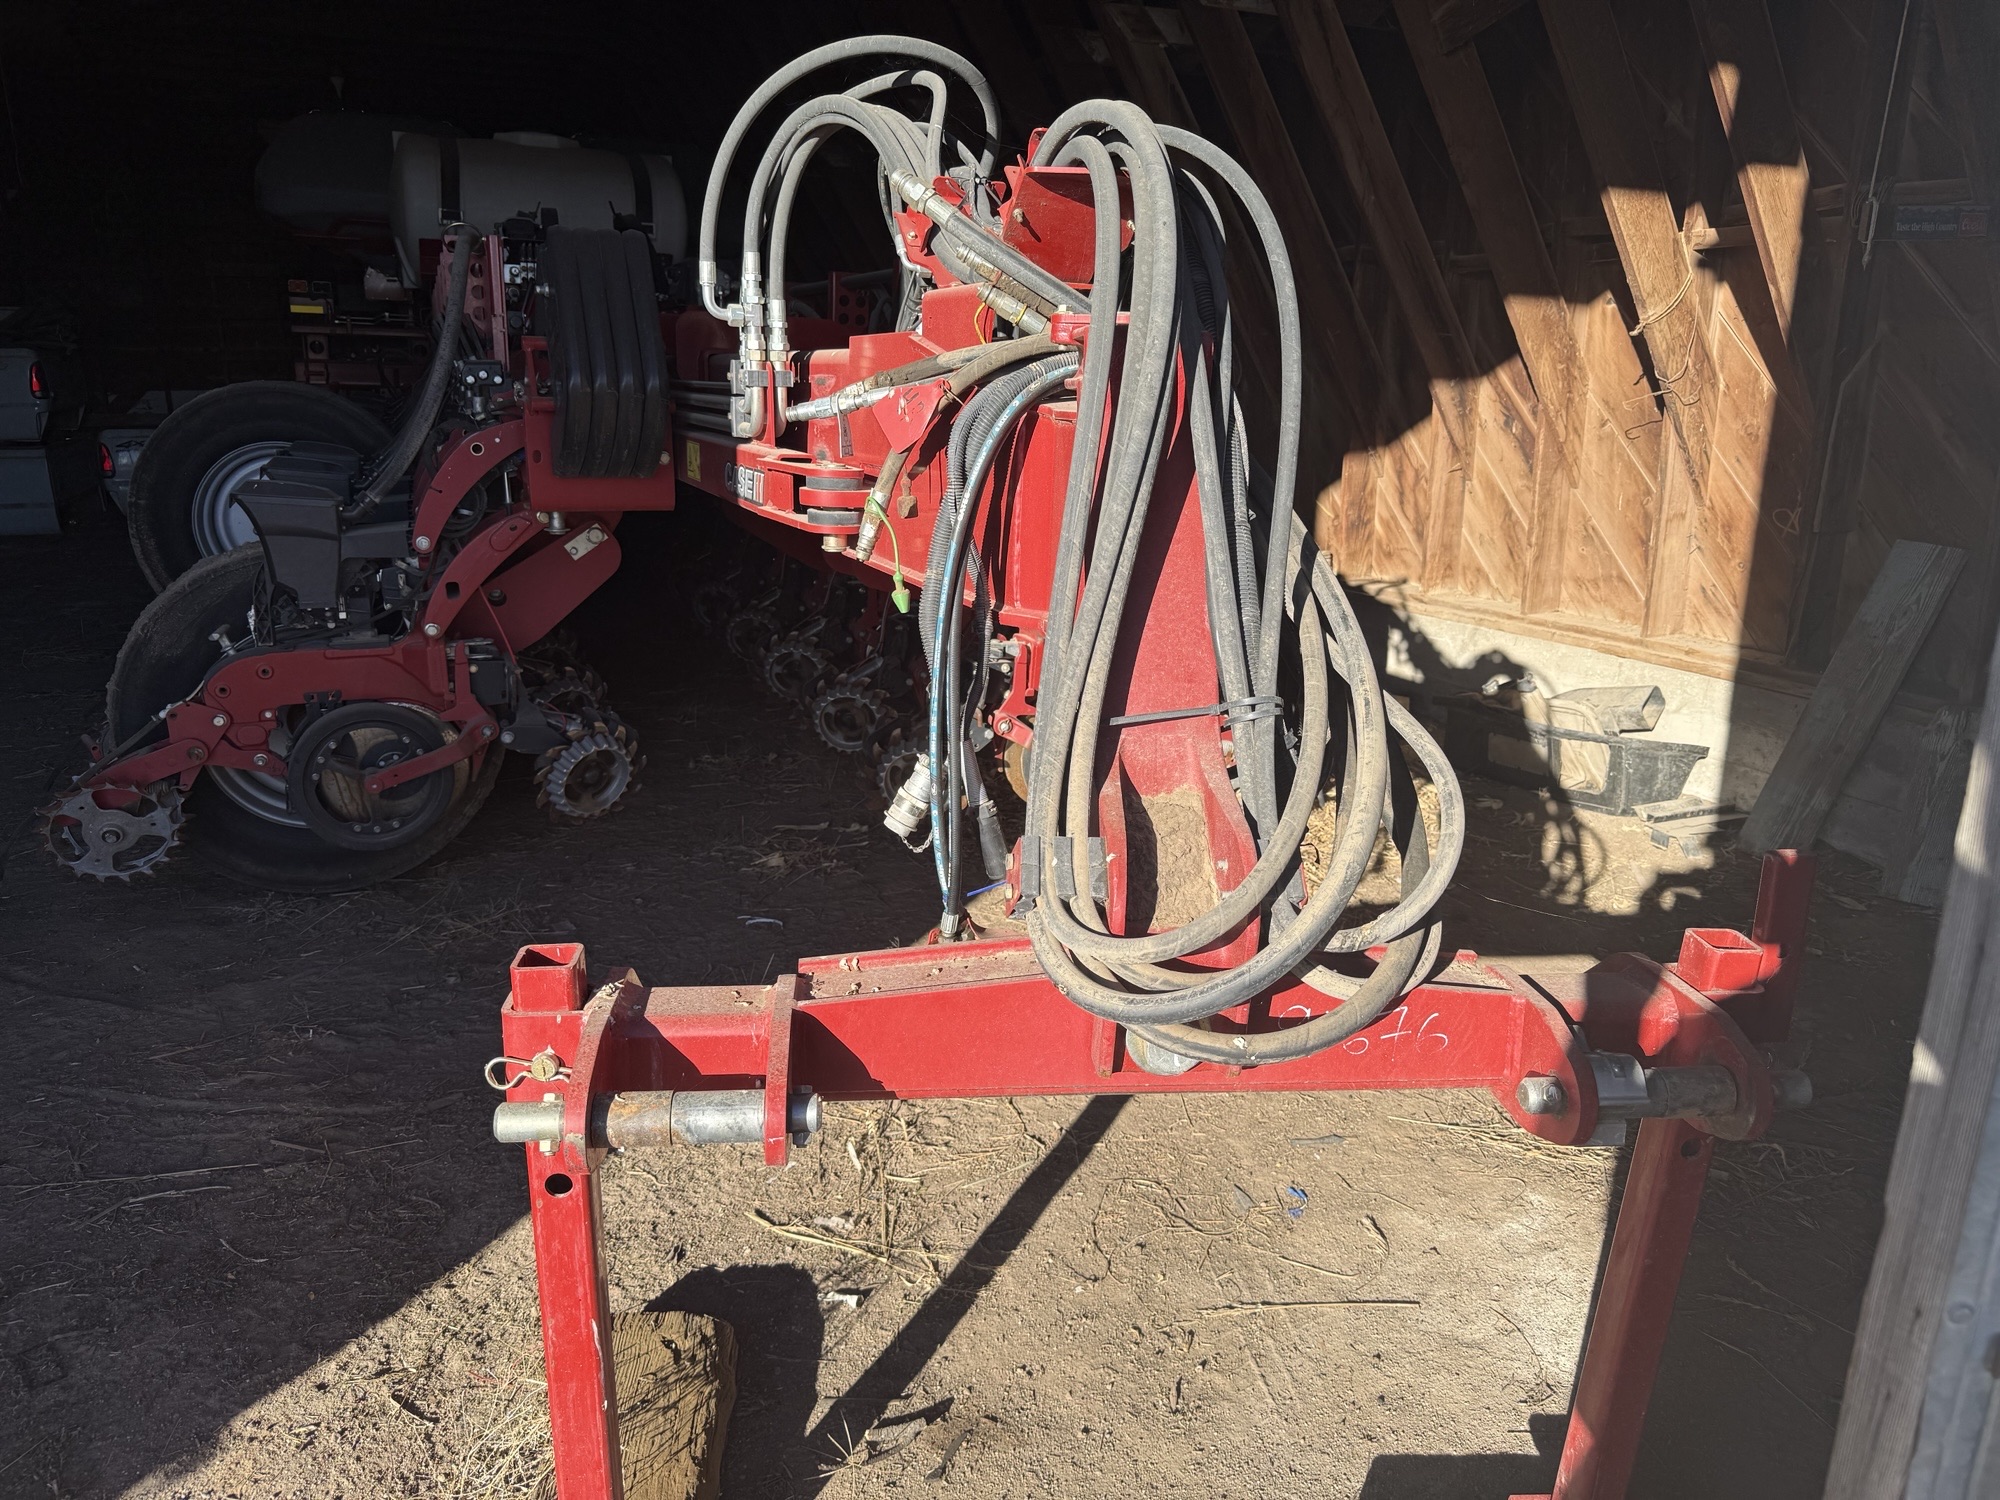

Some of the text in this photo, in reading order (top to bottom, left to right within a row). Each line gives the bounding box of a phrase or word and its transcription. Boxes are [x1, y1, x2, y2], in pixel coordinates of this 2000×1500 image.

[1896, 222, 1958, 233] Taste the High Country
[725, 462, 754, 500] CASE
